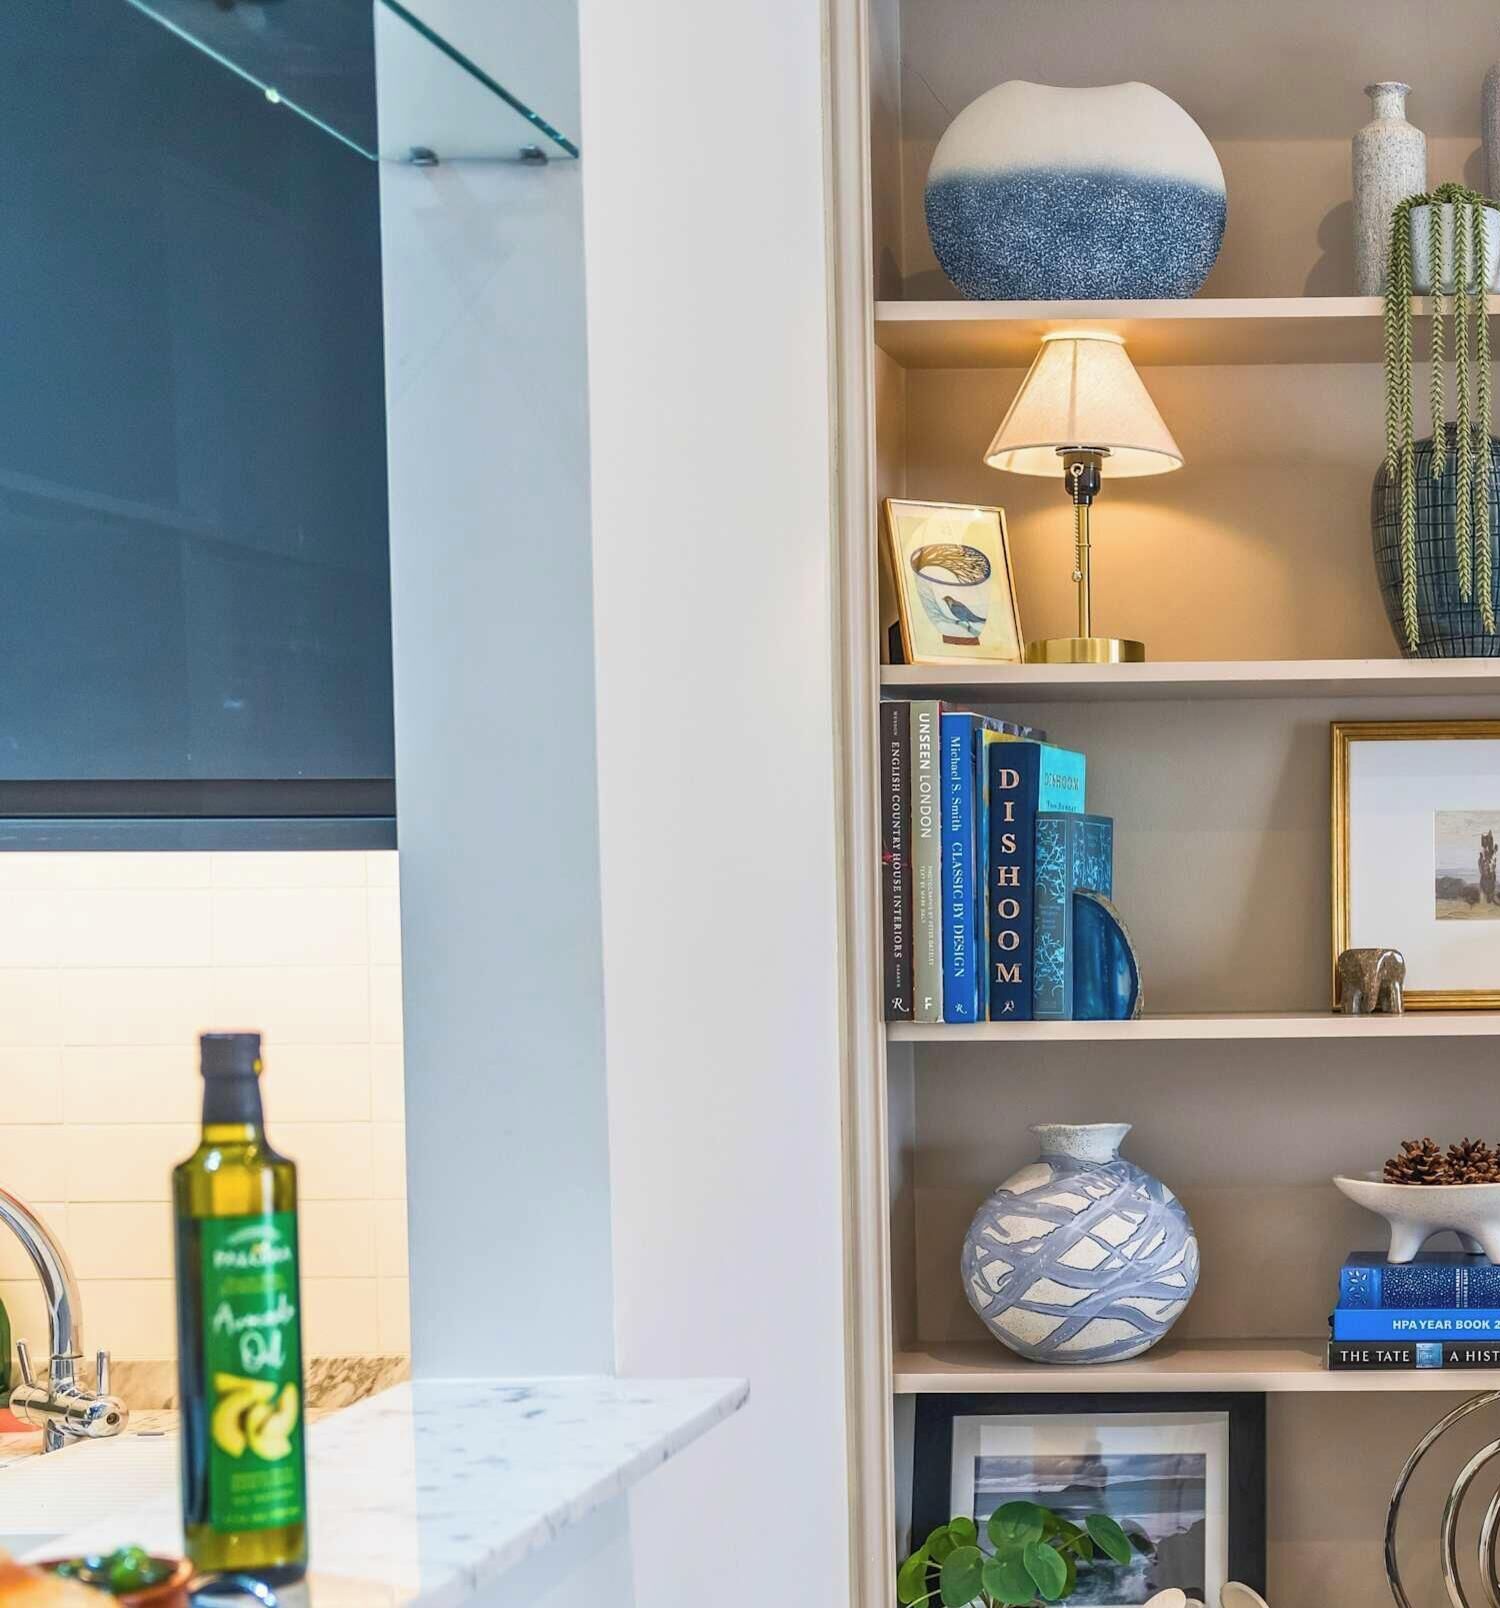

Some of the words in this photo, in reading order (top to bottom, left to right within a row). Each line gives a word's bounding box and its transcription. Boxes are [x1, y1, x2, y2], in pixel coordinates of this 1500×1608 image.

[919, 713, 931, 769] UNSEEN
[950, 736, 962, 781] Michael
[891, 742, 900, 792] ENGLISH
[950, 784, 962, 794] S.
[891, 795, 901, 850] COUNTRY
[920, 775, 932, 838] LONDON
[950, 797, 962, 831] Smith
[893, 854, 902, 892] HOUSE
[951, 842, 964, 899] CLASSIC
[994, 768, 1023, 984] DISHOOM
[893, 895, 902, 959] INTERIORS
[952, 903, 964, 920] BY
[952, 924, 965, 977] DESIGN
[1393, 1319, 1417, 1330] HPA
[1419, 1319, 1452, 1330] YEAR
[1455, 1319, 1490, 1330] BOOK
[239, 1328, 286, 1374] Oil
[1340, 1350, 1369, 1362] THE
[1376, 1350, 1410, 1362] TATE
[1449, 1350, 1459, 1362] A
